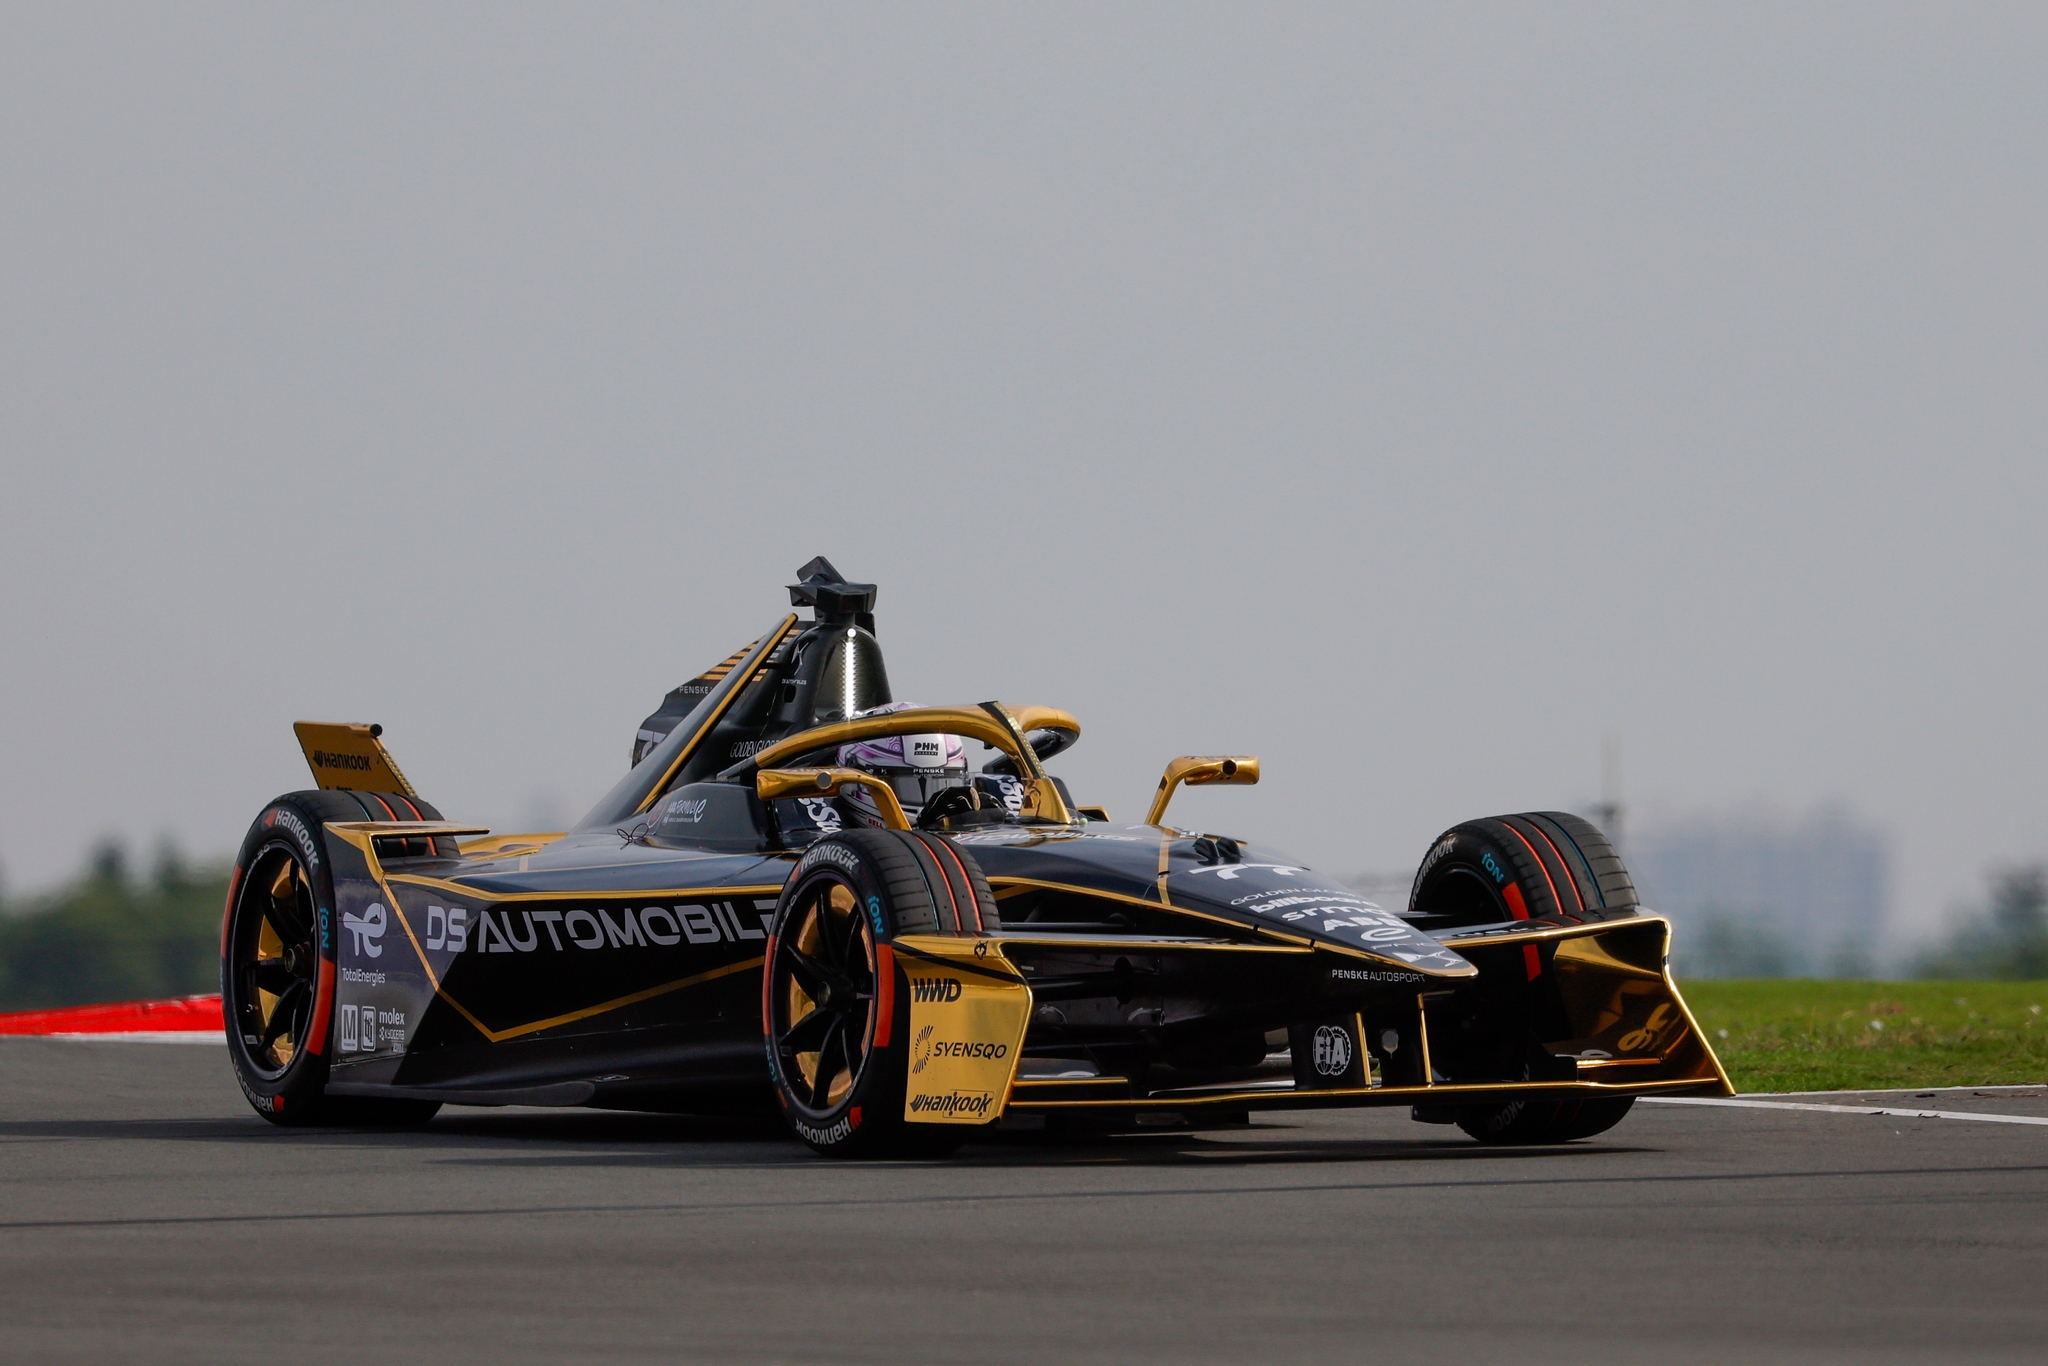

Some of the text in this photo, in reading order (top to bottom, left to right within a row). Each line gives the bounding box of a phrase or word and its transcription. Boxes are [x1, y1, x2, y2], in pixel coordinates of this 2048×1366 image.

[679, 686, 709, 694] PENSKE
[914, 742, 939, 751] PHM
[322, 752, 371, 771] Hankook
[867, 817, 884, 829] BELL
[274, 809, 320, 870] Hankook
[800, 844, 860, 873] Hankook
[1230, 887, 1301, 906] GOLDEN
[426, 905, 467, 952] DS
[342, 967, 386, 986] TotalEnergies
[1331, 969, 1426, 983] PENSKE AUTOSPORT
[912, 977, 962, 1003] WWD
[378, 1007, 405, 1025] molex
[933, 1041, 1007, 1060] SYENSQO
[920, 1094, 995, 1113] Hankook
[794, 1116, 853, 1145] Hankook
